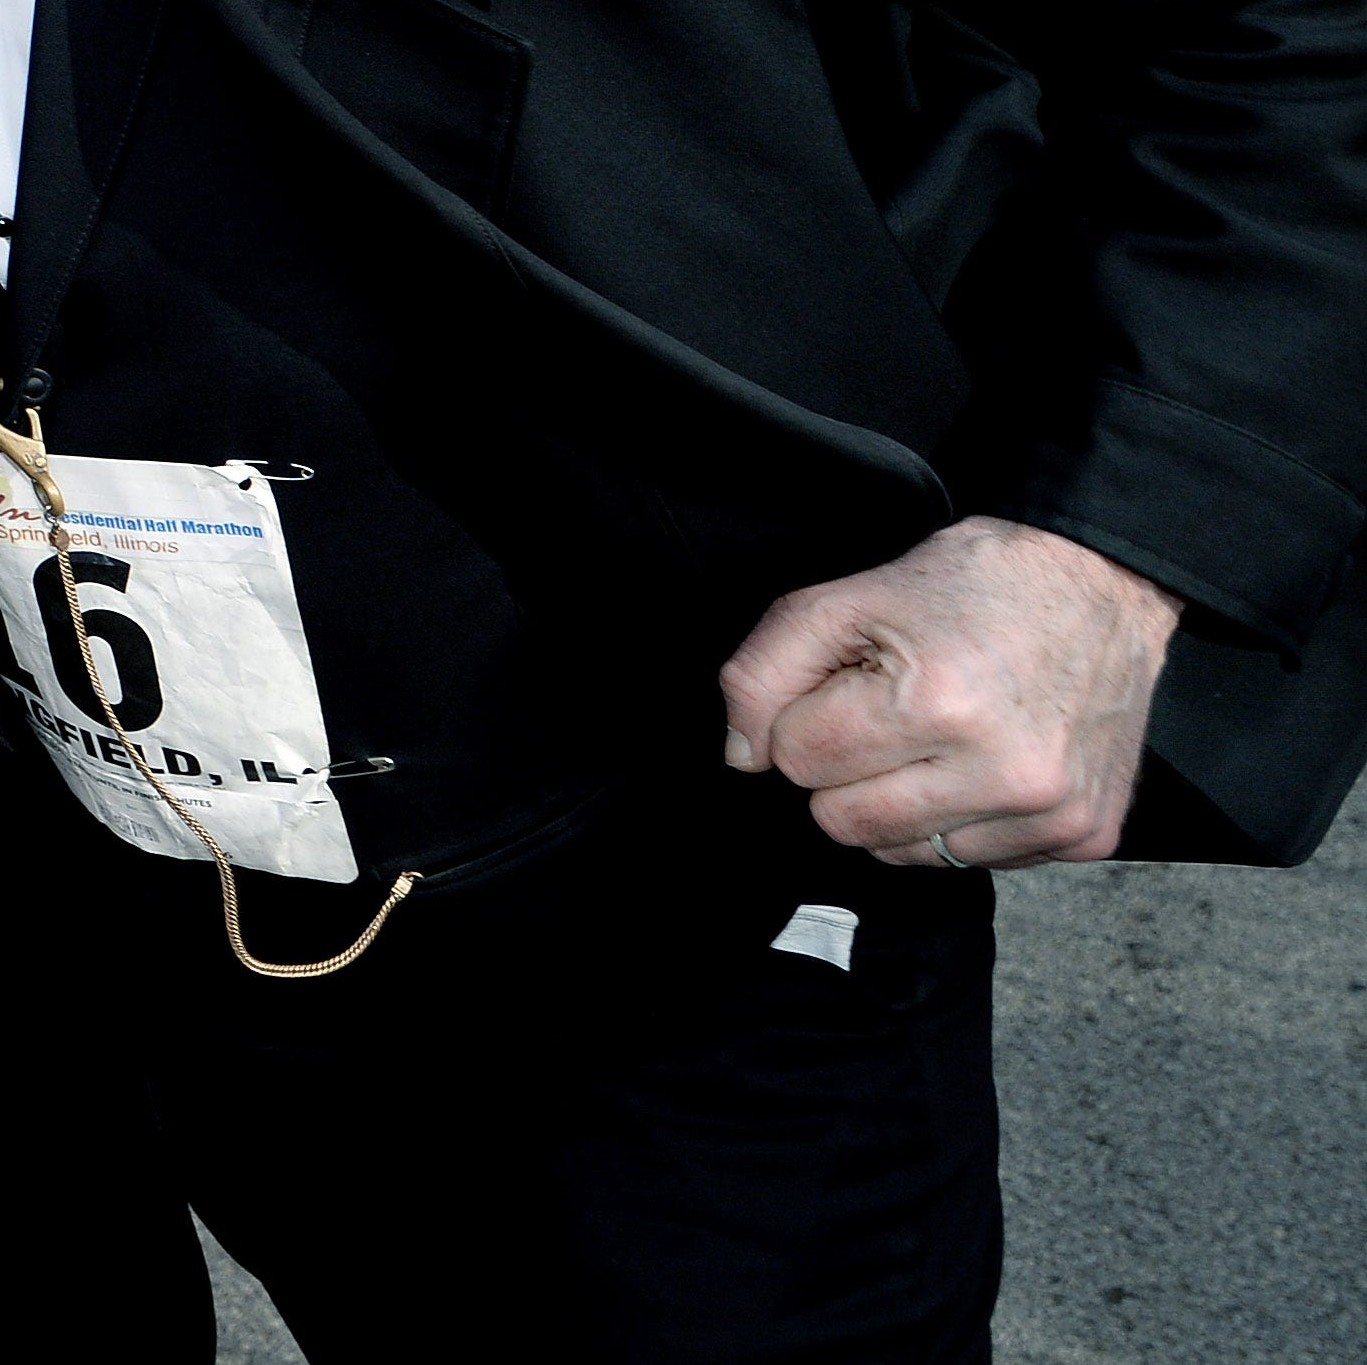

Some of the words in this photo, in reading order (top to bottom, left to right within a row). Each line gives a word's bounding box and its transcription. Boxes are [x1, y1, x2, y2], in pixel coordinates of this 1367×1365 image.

[61, 511, 142, 532] esidential
[145, 519, 178, 534] Half
[181, 520, 264, 539] Marathon
[114, 534, 180, 554] Illinois
[240, 757, 298, 785] IL
